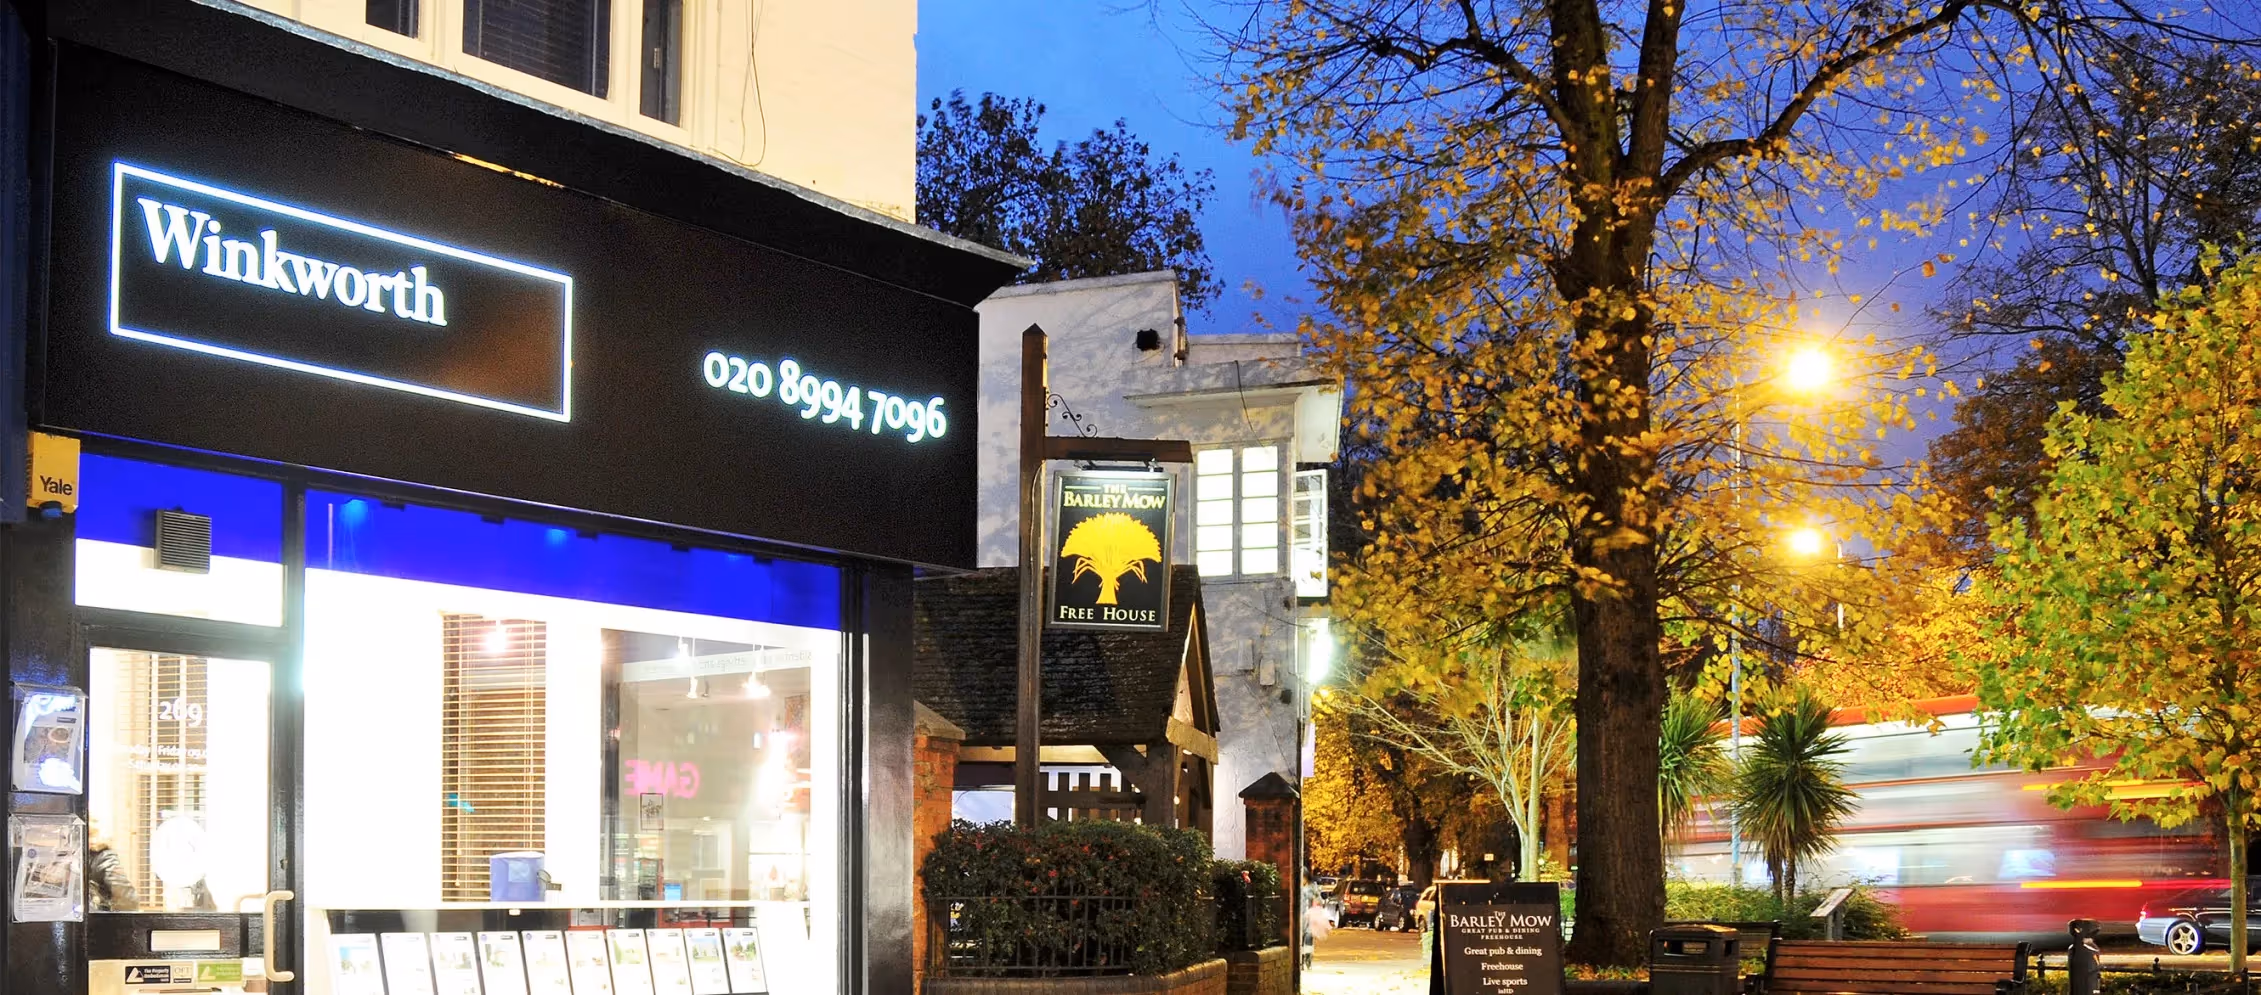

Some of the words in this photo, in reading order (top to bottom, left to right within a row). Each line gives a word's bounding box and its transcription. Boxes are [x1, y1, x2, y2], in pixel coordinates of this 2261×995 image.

[137, 197, 447, 327] Winkworth
[703, 352, 773, 398] 020
[779, 359, 864, 430] 8994
[868, 390, 947, 443] 7096
[40, 475, 72, 496] Yale
[1103, 484, 1127, 494] THE
[1063, 491, 1122, 508] BARLEY
[1059, 605, 1094, 620] FREE
[1103, 606, 1156, 622] HOUSE
[159, 698, 202, 728] 269
[1450, 914, 1506, 928] BARLEY
[1510, 914, 1552, 927] MOW
[1464, 947, 1488, 955] Great
[1489, 947, 1506, 956] pub
[1507, 947, 1514, 955] &
[1515, 947, 1542, 956] dining
[1481, 962, 1524, 970] Freehouse
[1482, 977, 1500, 986] Live
[1502, 978, 1528, 987] sports
